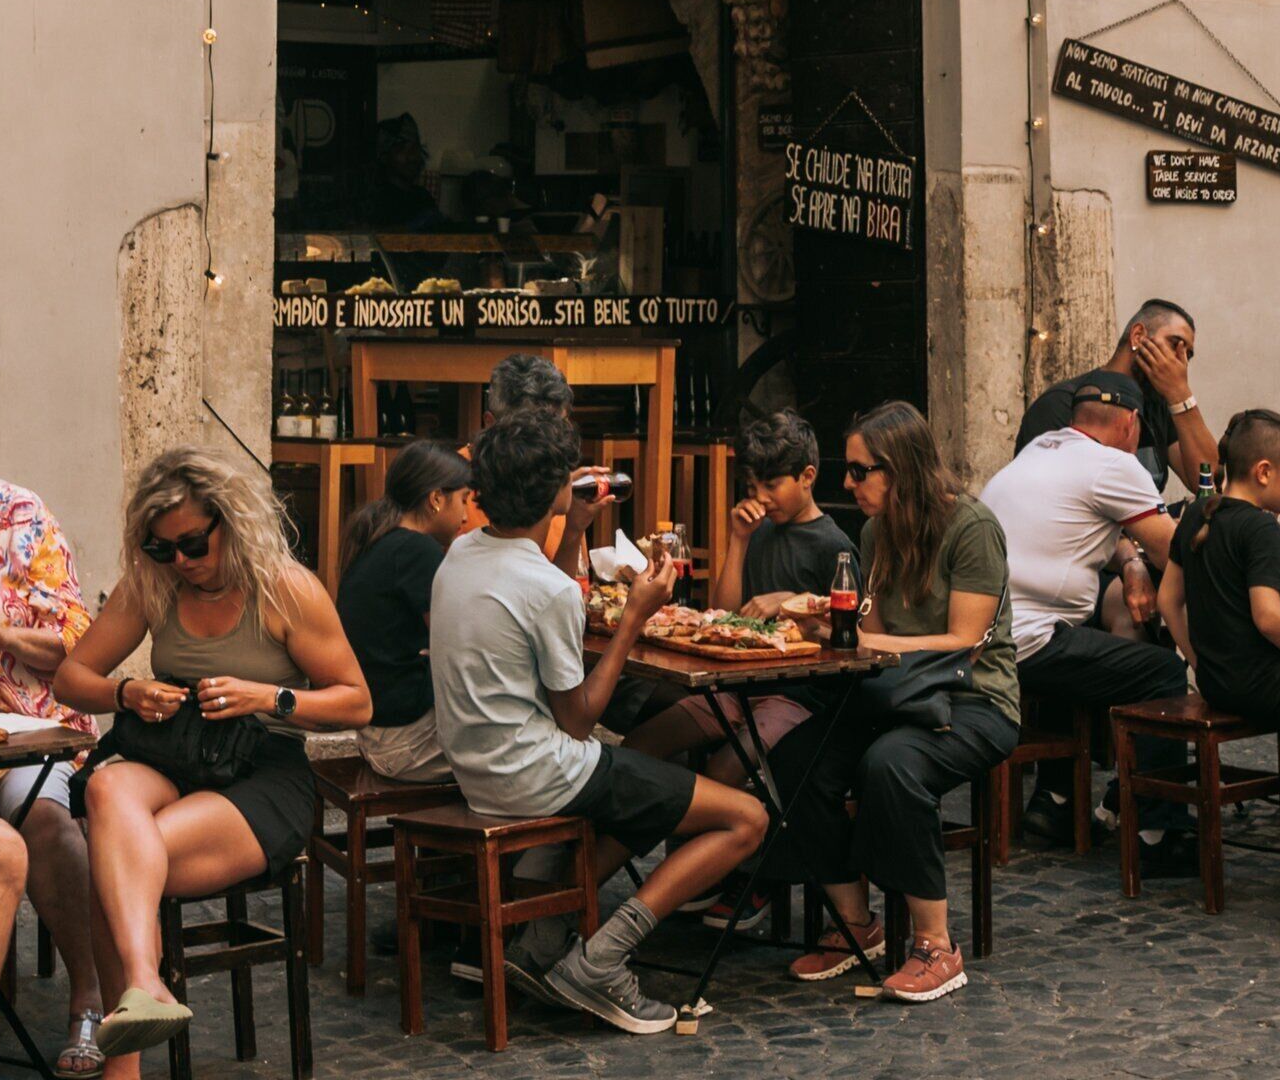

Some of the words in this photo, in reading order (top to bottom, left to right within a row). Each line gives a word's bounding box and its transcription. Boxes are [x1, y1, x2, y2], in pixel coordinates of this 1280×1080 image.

[1174, 80, 1190, 99] MA
[1066, 71, 1082, 91] AL
[1153, 100, 1168, 120] TI
[1176, 113, 1205, 133] DEVI
[1210, 125, 1226, 146] DA
[785, 143, 802, 181] SE
[876, 158, 912, 199] PORTA
[1153, 155, 1166, 167] WE
[1171, 155, 1193, 167] DON'T
[1198, 156, 1220, 168] HAVE
[1153, 170, 1179, 183] TABLE
[1184, 171, 1218, 184] SERVICE
[789, 184, 807, 225] SE
[808, 189, 838, 231] APRE
[1200, 189, 1210, 200] TO
[1212, 189, 1236, 202] ORDER
[336, 298, 346, 327] E
[354, 296, 434, 327] INDOSSATE
[442, 299, 464, 326] UN
[594, 298, 631, 326] BENE
[665, 297, 718, 323] TUTTO
